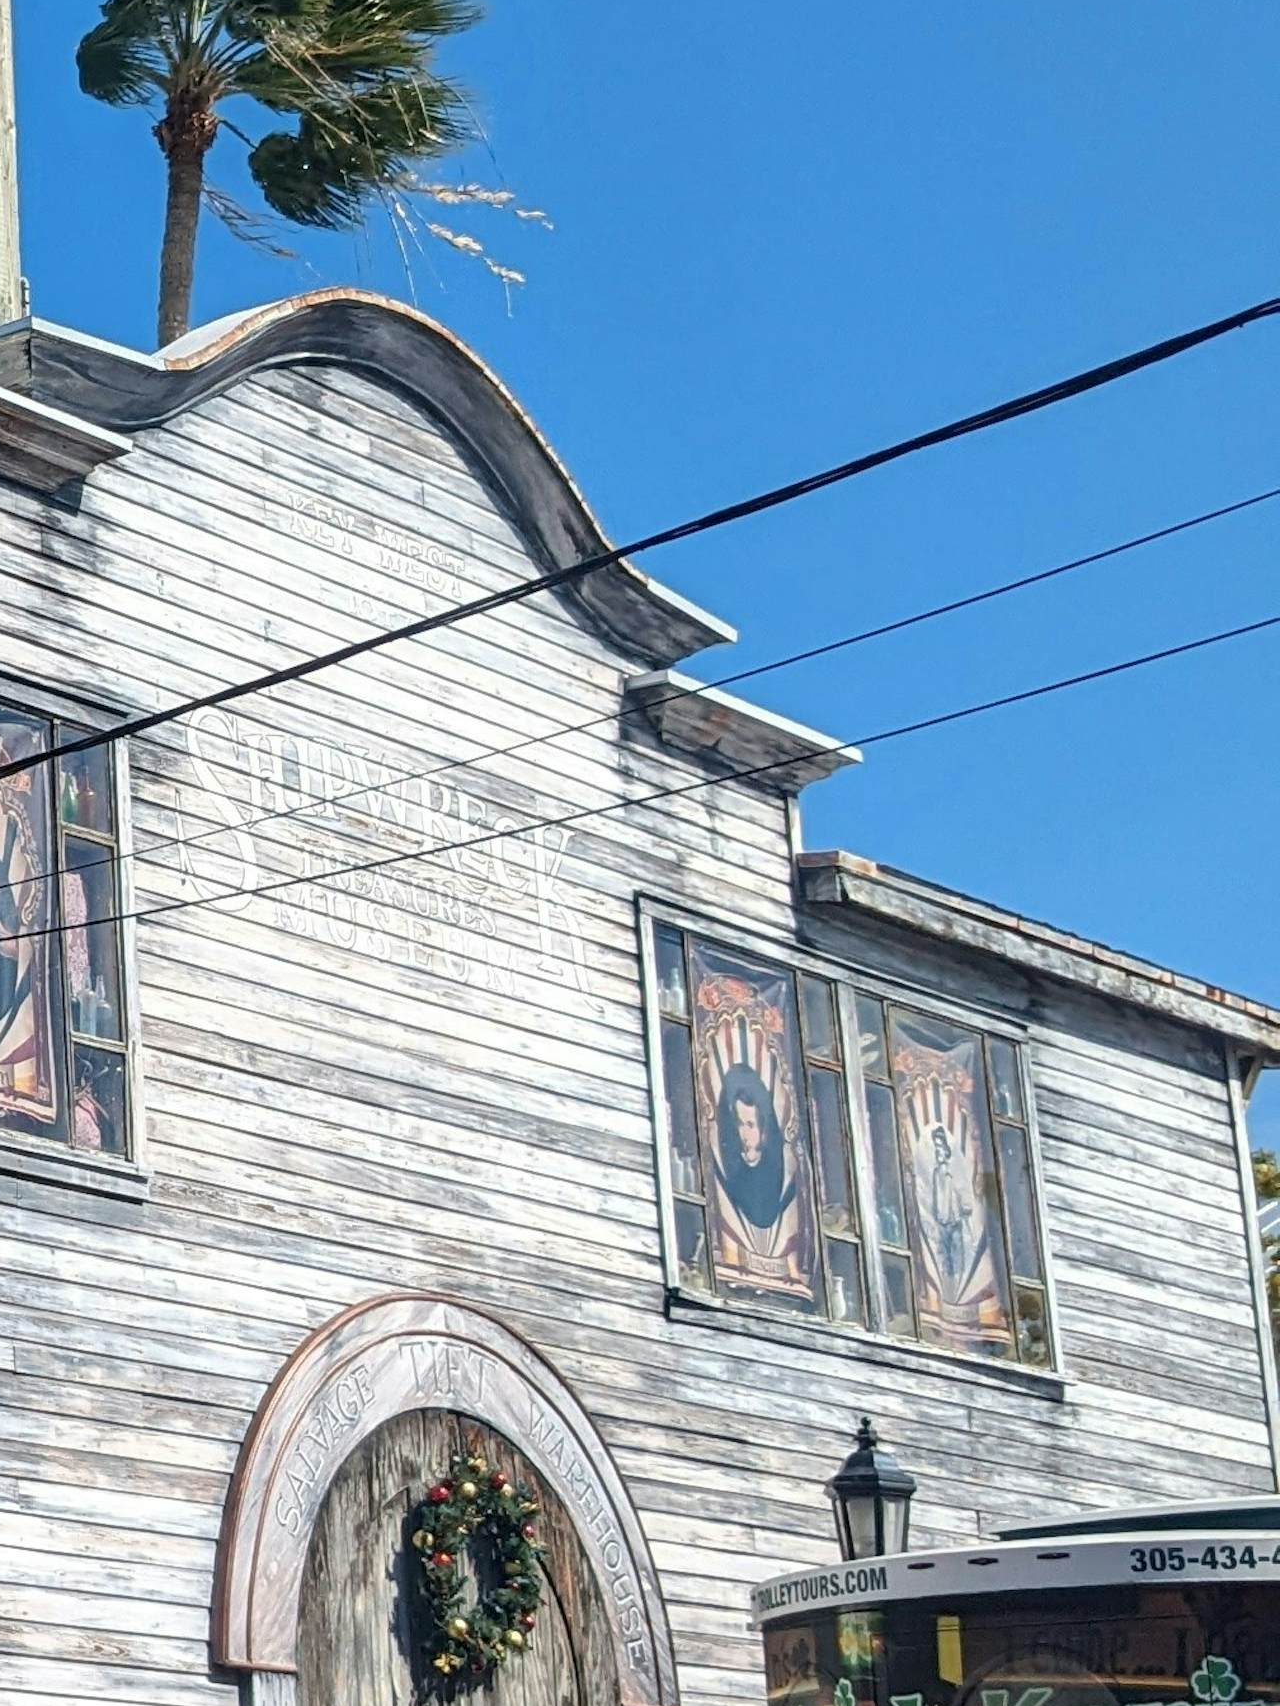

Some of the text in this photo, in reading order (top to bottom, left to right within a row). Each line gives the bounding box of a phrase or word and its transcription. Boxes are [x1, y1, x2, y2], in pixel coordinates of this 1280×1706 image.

[175, 705, 607, 1016] SHIPWRECK
[274, 1364, 376, 1537] SALVAGE
[527, 1399, 647, 1671] WAREHOUSE
